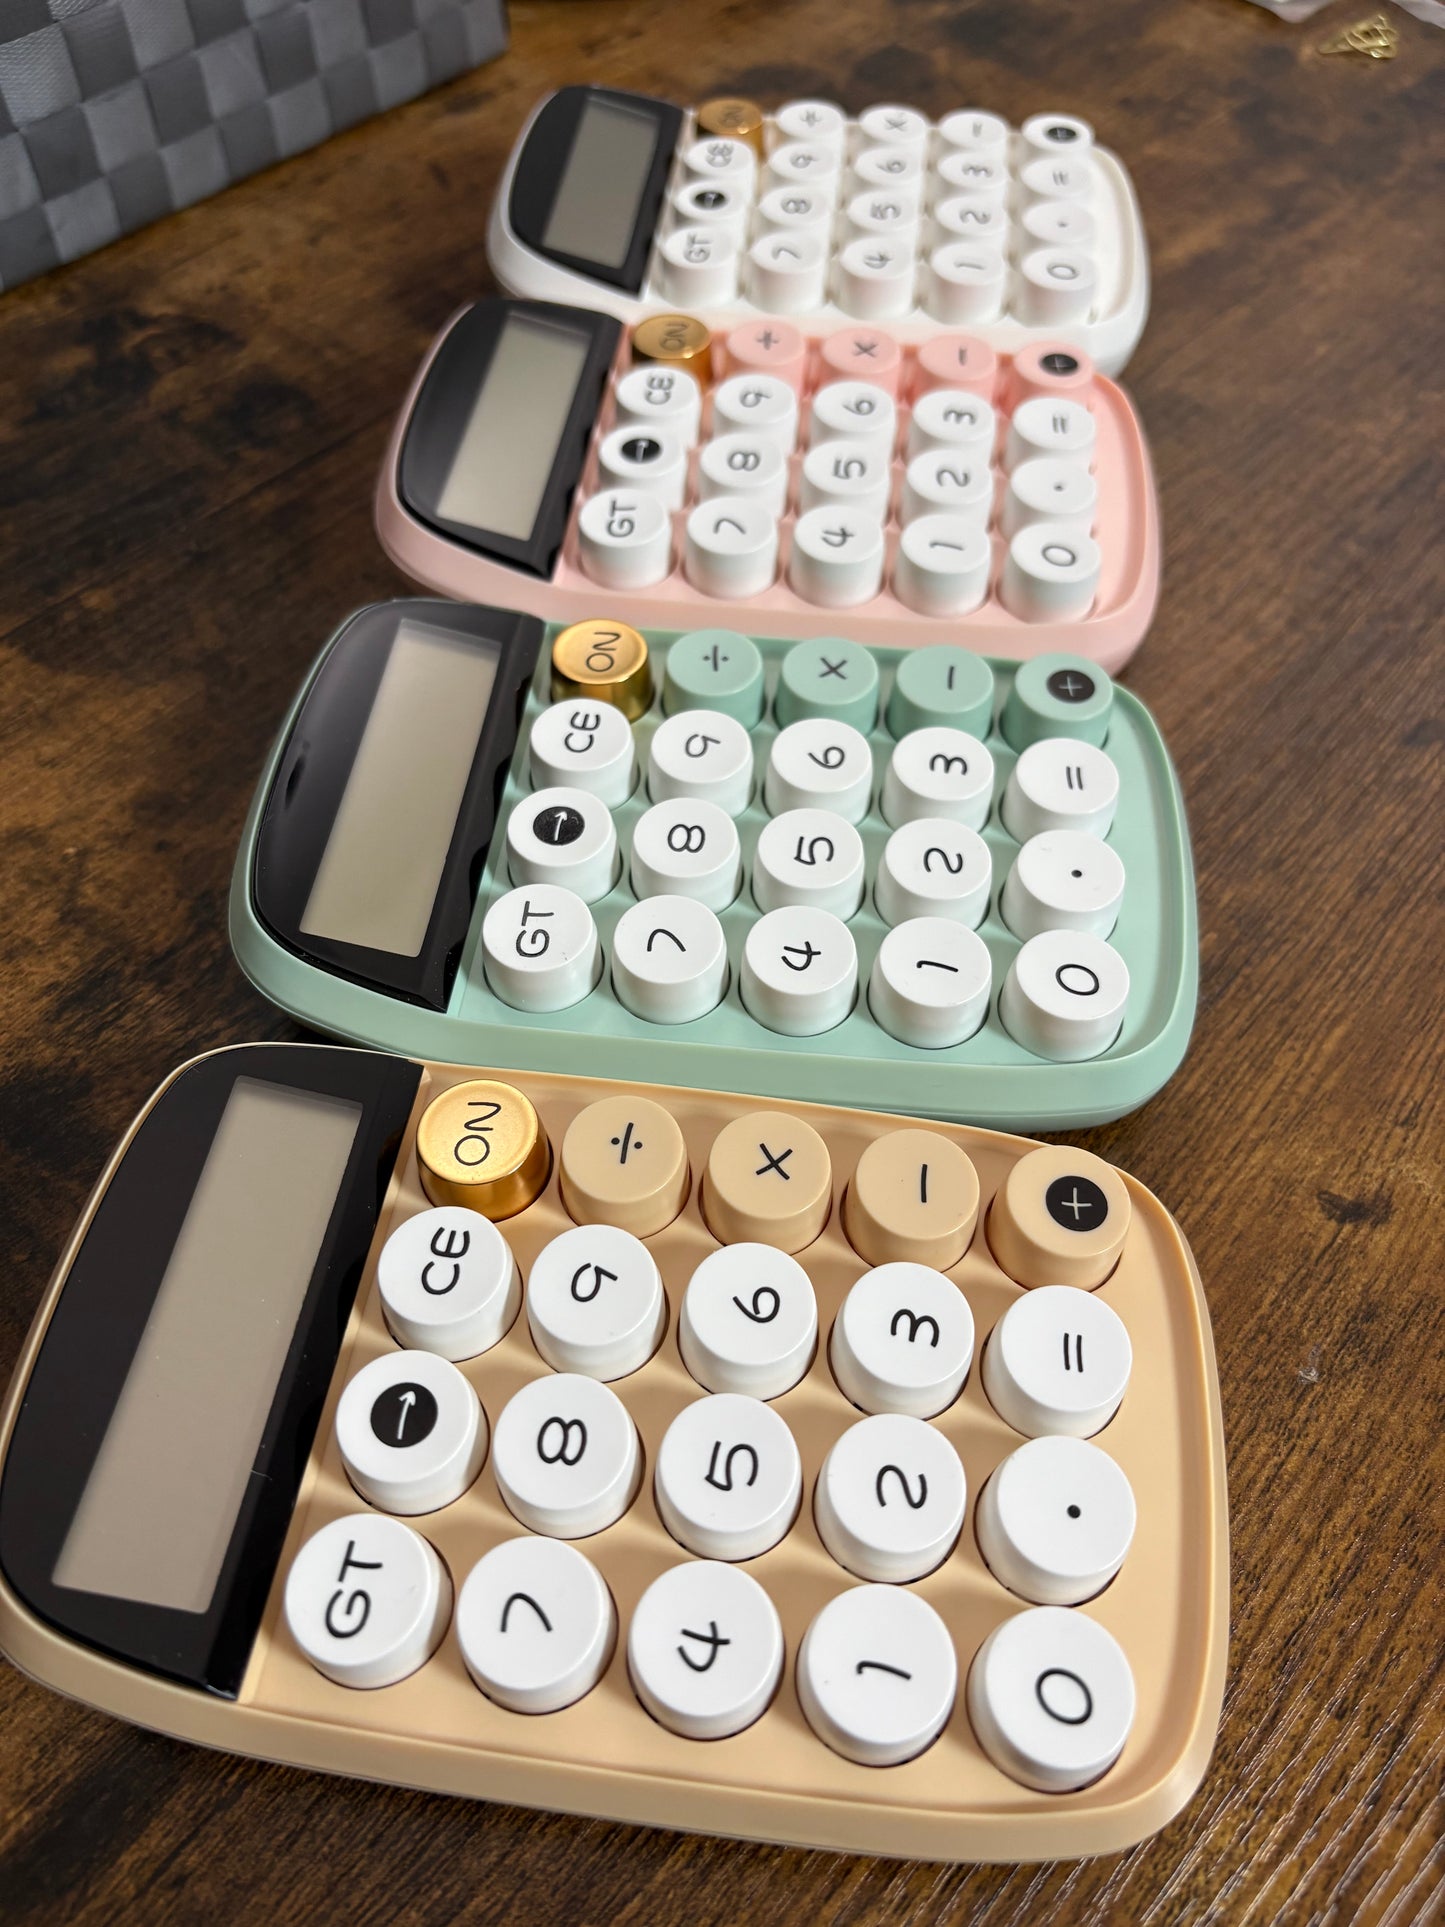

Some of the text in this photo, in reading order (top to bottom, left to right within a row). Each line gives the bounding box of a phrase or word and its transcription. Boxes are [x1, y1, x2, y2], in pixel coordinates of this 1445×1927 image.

[658, 323, 688, 352] ON
[644, 376, 675, 405] CE
[739, 390, 772, 409] 9
[842, 397, 876, 417] 6
[943, 408, 976, 424] 3
[727, 450, 761, 471] 8
[833, 459, 867, 480] 5
[935, 468, 971, 487] 2
[606, 500, 635, 538] GT
[713, 517, 746, 535] 7
[822, 527, 853, 547] 4
[929, 540, 964, 551] 1
[1041, 544, 1078, 567] 0
[585, 631, 625, 675] ON
[563, 711, 601, 754] CE
[684, 733, 721, 758] 9
[807, 745, 846, 770] 6
[929, 753, 968, 775] 3
[667, 823, 706, 854] 8
[793, 836, 835, 866] 5
[923, 847, 964, 875] 2
[515, 900, 554, 958] GT
[646, 928, 686, 953] 7
[781, 940, 822, 972] 4
[916, 960, 959, 973] 1
[1055, 963, 1100, 997] 0
[453, 1101, 502, 1167] ON
[420, 1226, 471, 1296] CE
[570, 1262, 618, 1303] 9
[732, 1286, 781, 1324] 6
[890, 1308, 940, 1348] 3
[536, 1416, 588, 1467] 8
[704, 1440, 759, 1492] 5
[875, 1464, 928, 1510] 2
[324, 1540, 383, 1640] GT
[500, 1592, 553, 1633] 7
[677, 1621, 731, 1673] 4
[856, 1660, 912, 1681] 1
[1035, 1668, 1094, 1726] 0
